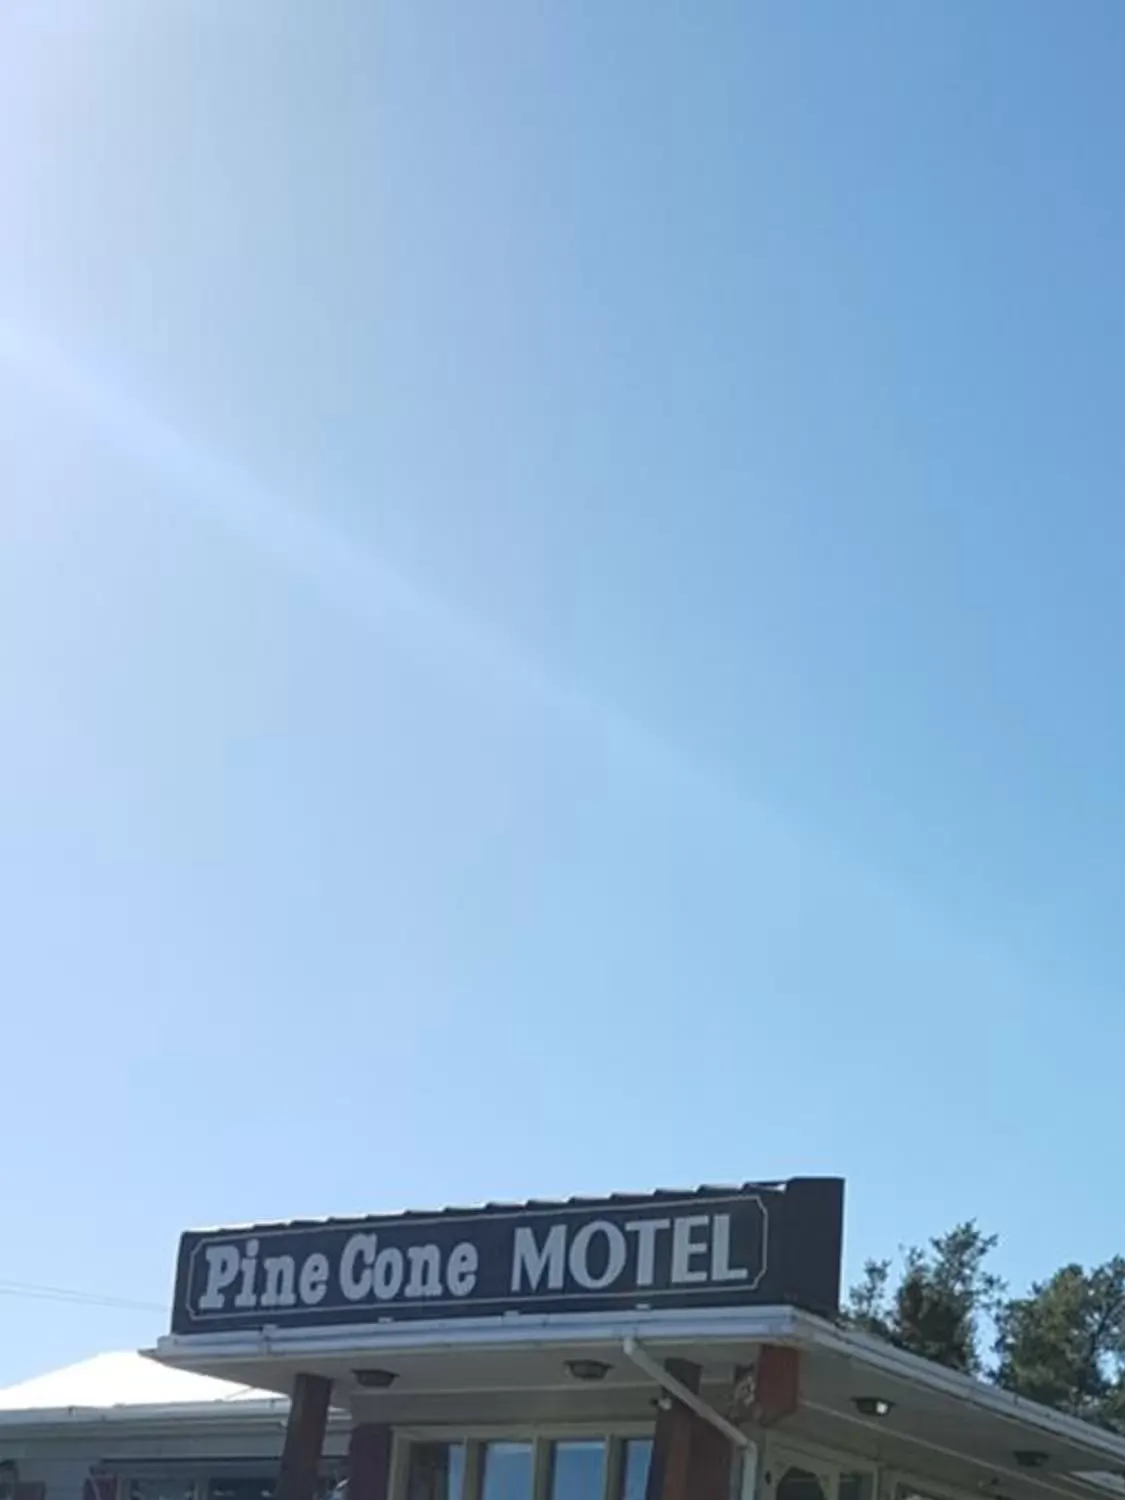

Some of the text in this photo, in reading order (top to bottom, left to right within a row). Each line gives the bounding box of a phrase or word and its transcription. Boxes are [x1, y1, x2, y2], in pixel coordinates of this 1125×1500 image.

[201, 1214, 747, 1309] Pine Cone MOTEL
